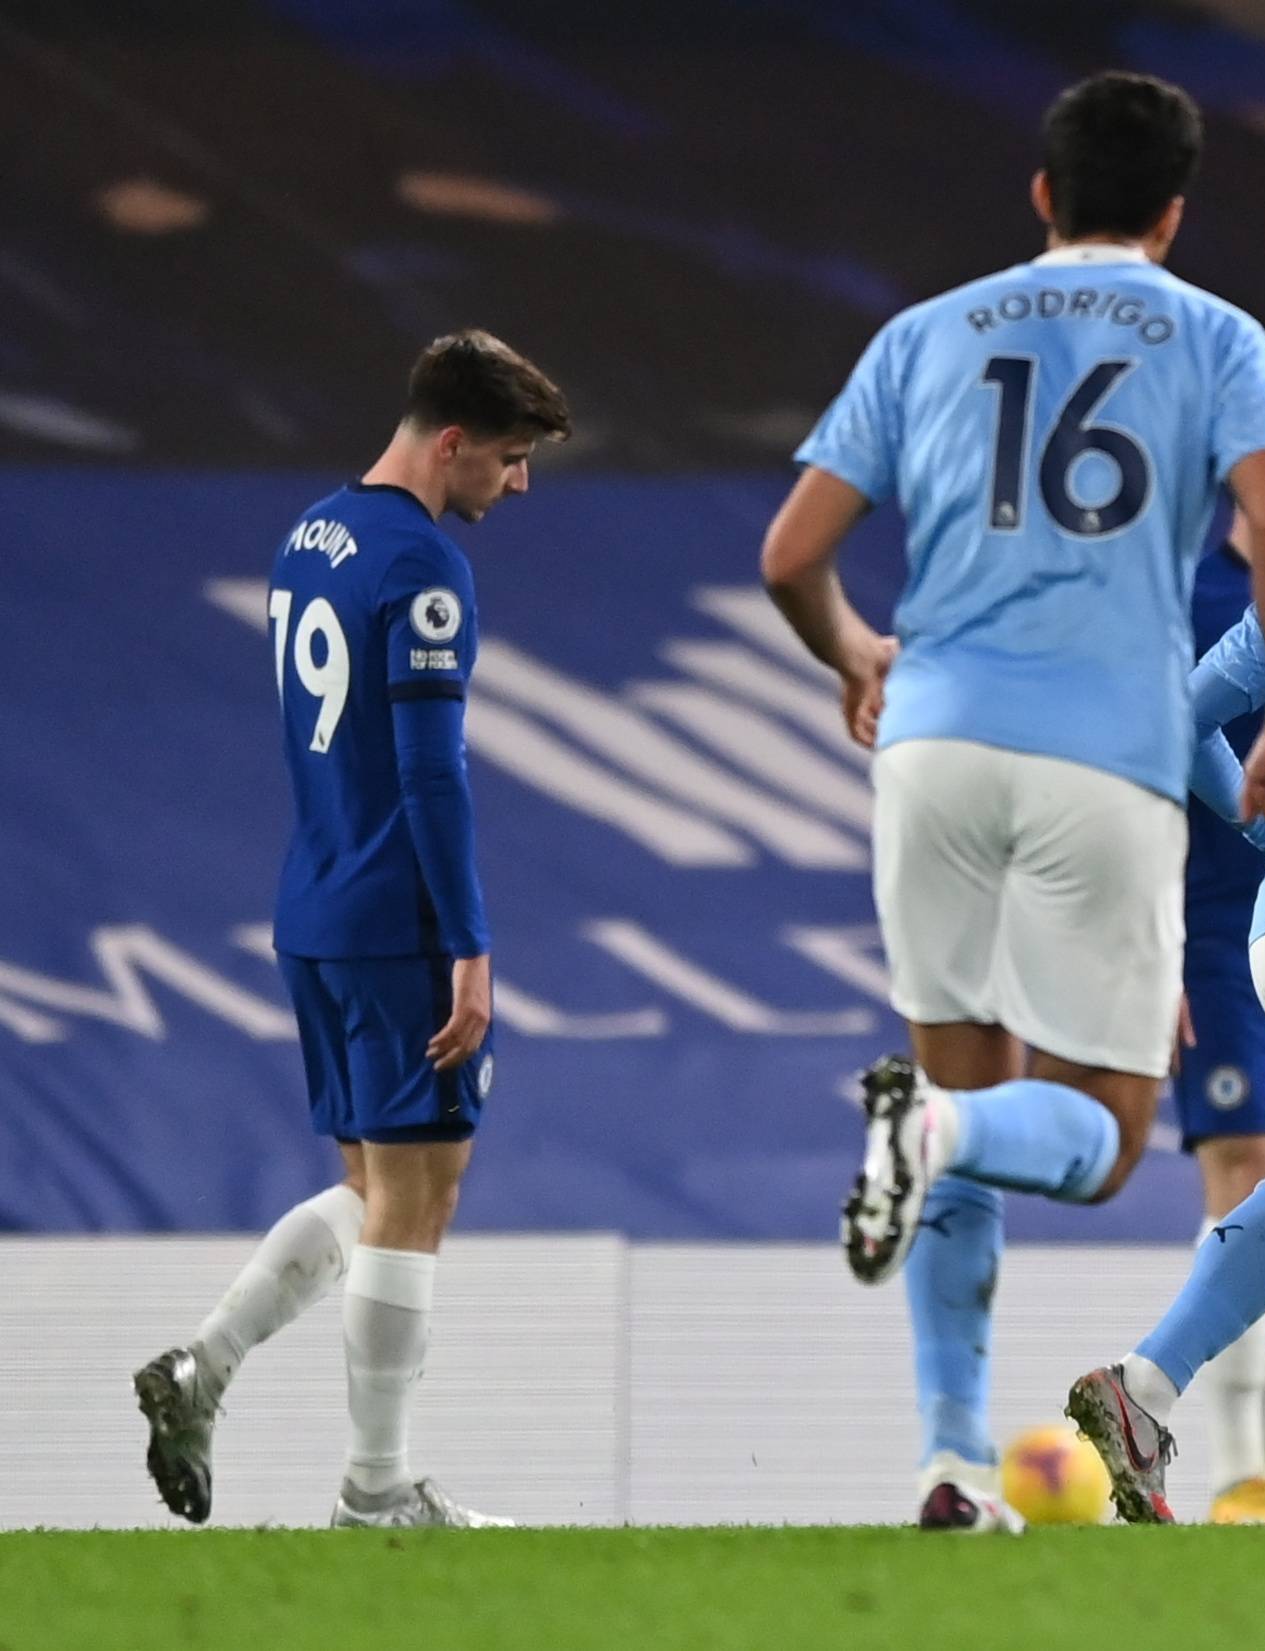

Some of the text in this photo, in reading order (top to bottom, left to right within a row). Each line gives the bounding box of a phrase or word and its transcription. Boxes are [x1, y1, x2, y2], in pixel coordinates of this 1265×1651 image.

[967, 288, 1175, 345] RODRIGO
[980, 355, 1154, 540] 16
[284, 519, 358, 570] MOUNT
[269, 588, 350, 754] 19
